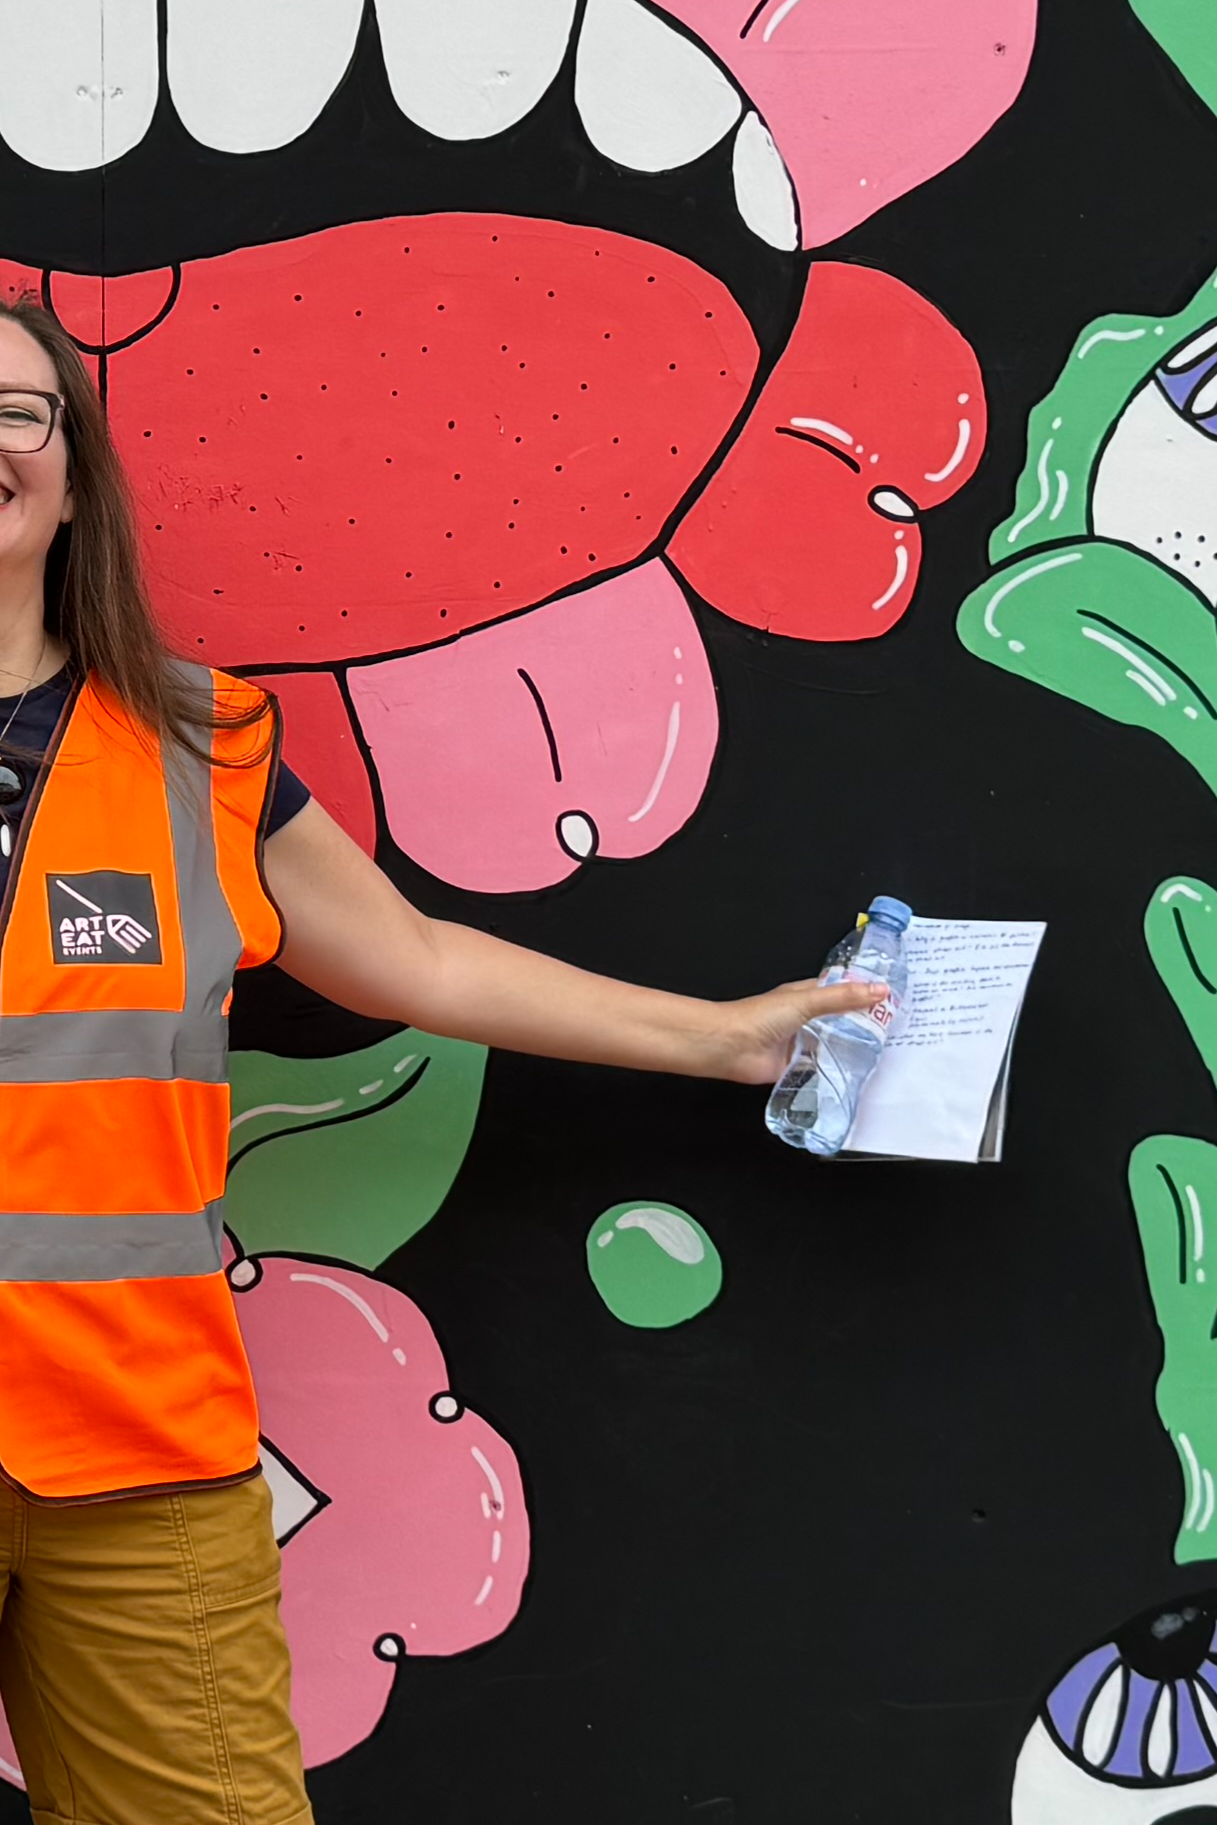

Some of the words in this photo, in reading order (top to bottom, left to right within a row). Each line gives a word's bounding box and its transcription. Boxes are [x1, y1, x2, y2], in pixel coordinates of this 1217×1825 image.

[59, 915, 104, 933] ART
[61, 930, 105, 946] EAT
[62, 946, 103, 956] EVENTS
